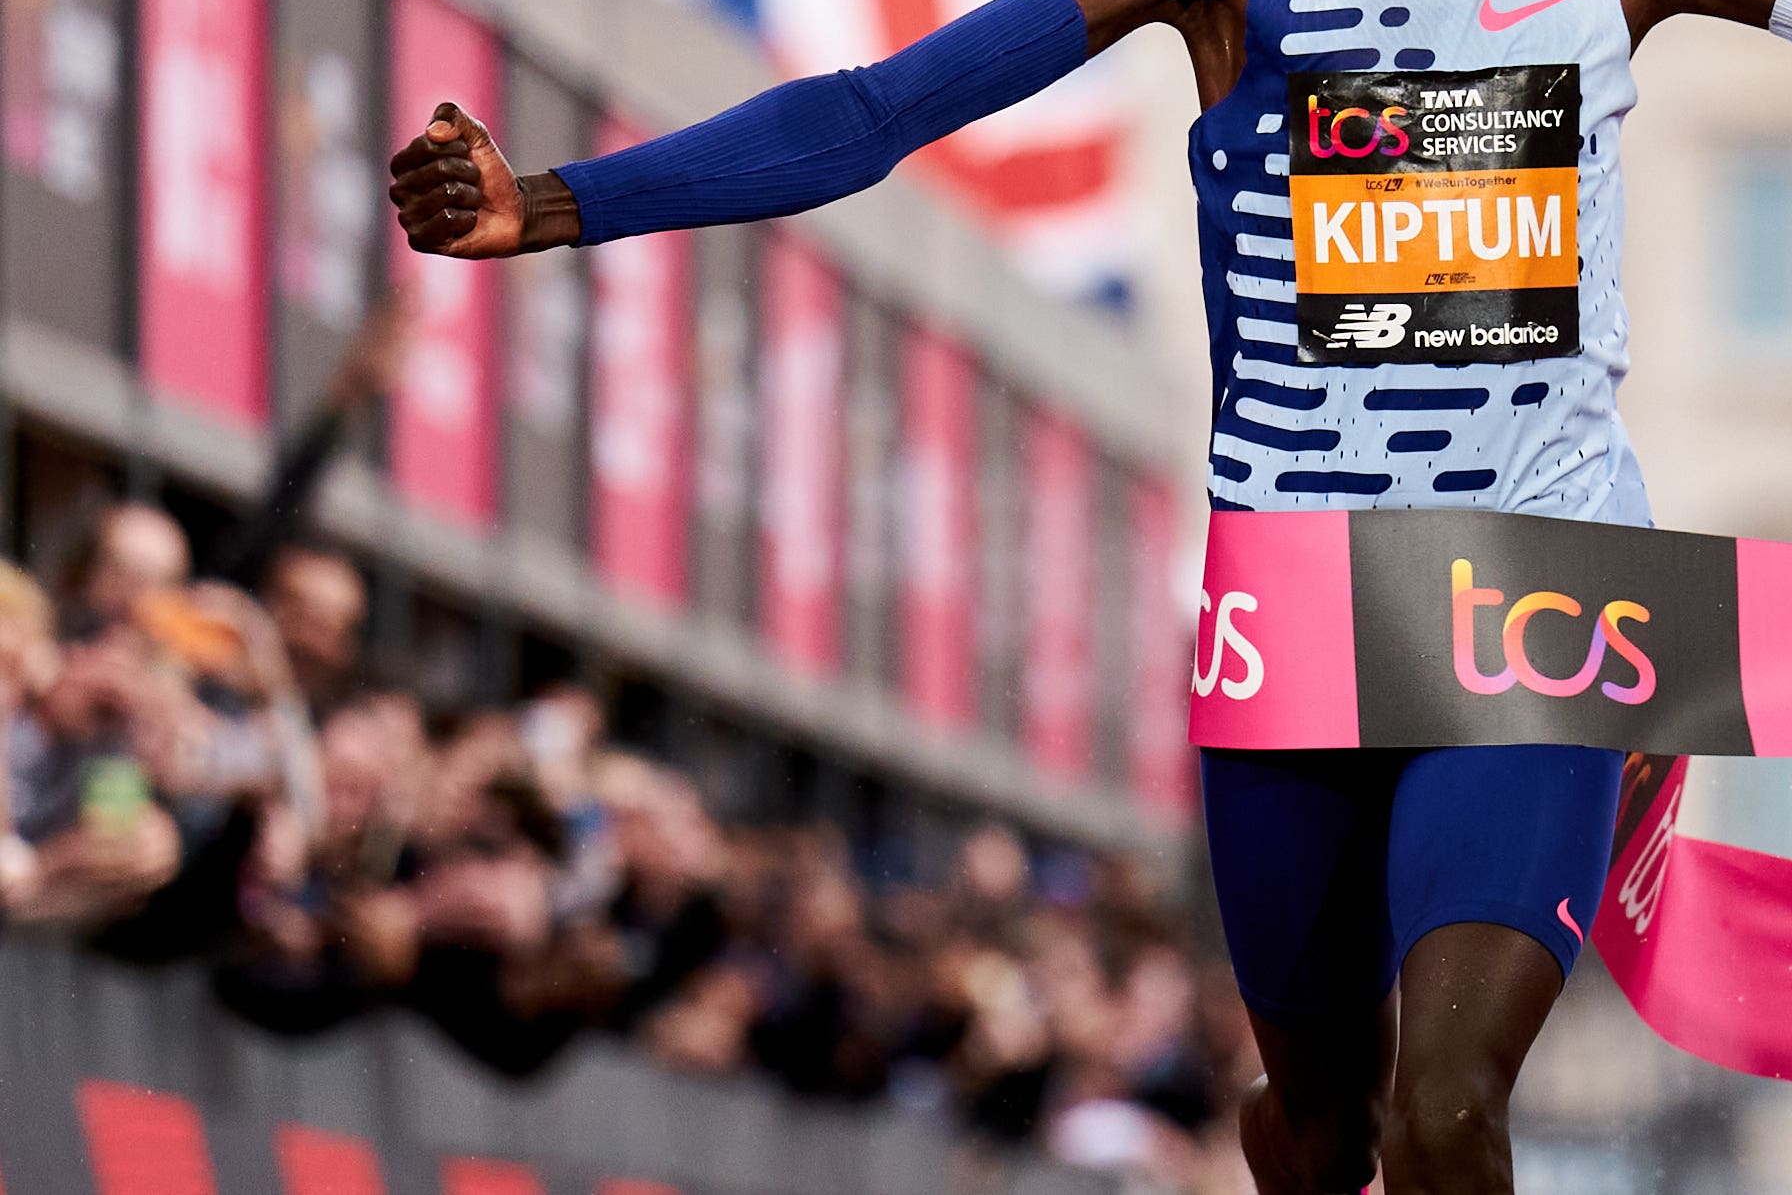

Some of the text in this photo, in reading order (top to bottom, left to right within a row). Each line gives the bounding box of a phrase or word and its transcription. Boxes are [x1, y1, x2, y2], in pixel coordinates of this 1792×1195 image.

[1420, 89, 1484, 109] TATA
[1308, 94, 1410, 158] tcs
[1421, 109, 1565, 133] CONSULTANCY
[1422, 134, 1517, 156] SERVICES
[1365, 178, 1383, 190] tcs
[1415, 175, 1518, 190] #WeRunTogether
[1313, 195, 1562, 264] KIPTUM
[1414, 322, 1559, 348] new balance
[1191, 588, 1264, 700] cs
[1451, 558, 1656, 705] tcs
